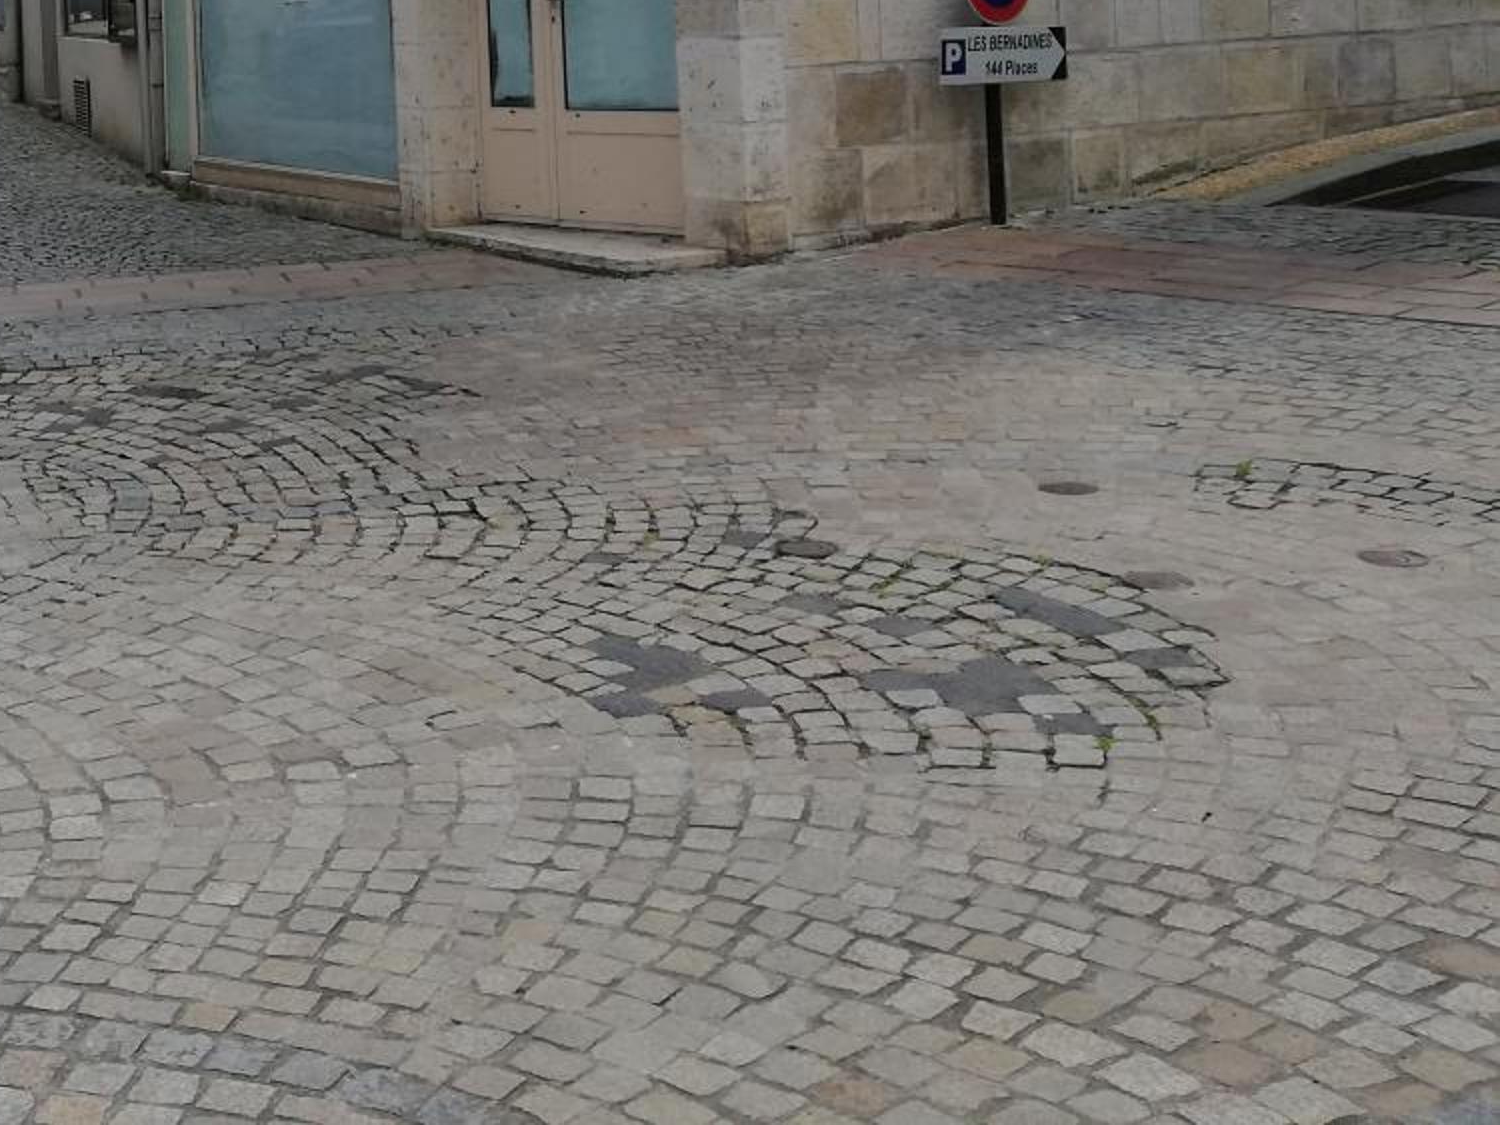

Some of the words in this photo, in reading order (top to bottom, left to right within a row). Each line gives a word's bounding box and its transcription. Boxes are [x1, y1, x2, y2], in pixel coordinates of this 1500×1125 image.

[945, 42, 963, 72] P
[967, 34, 987, 52] LES
[985, 60, 1003, 75] 144
[1005, 60, 1038, 75] Places
